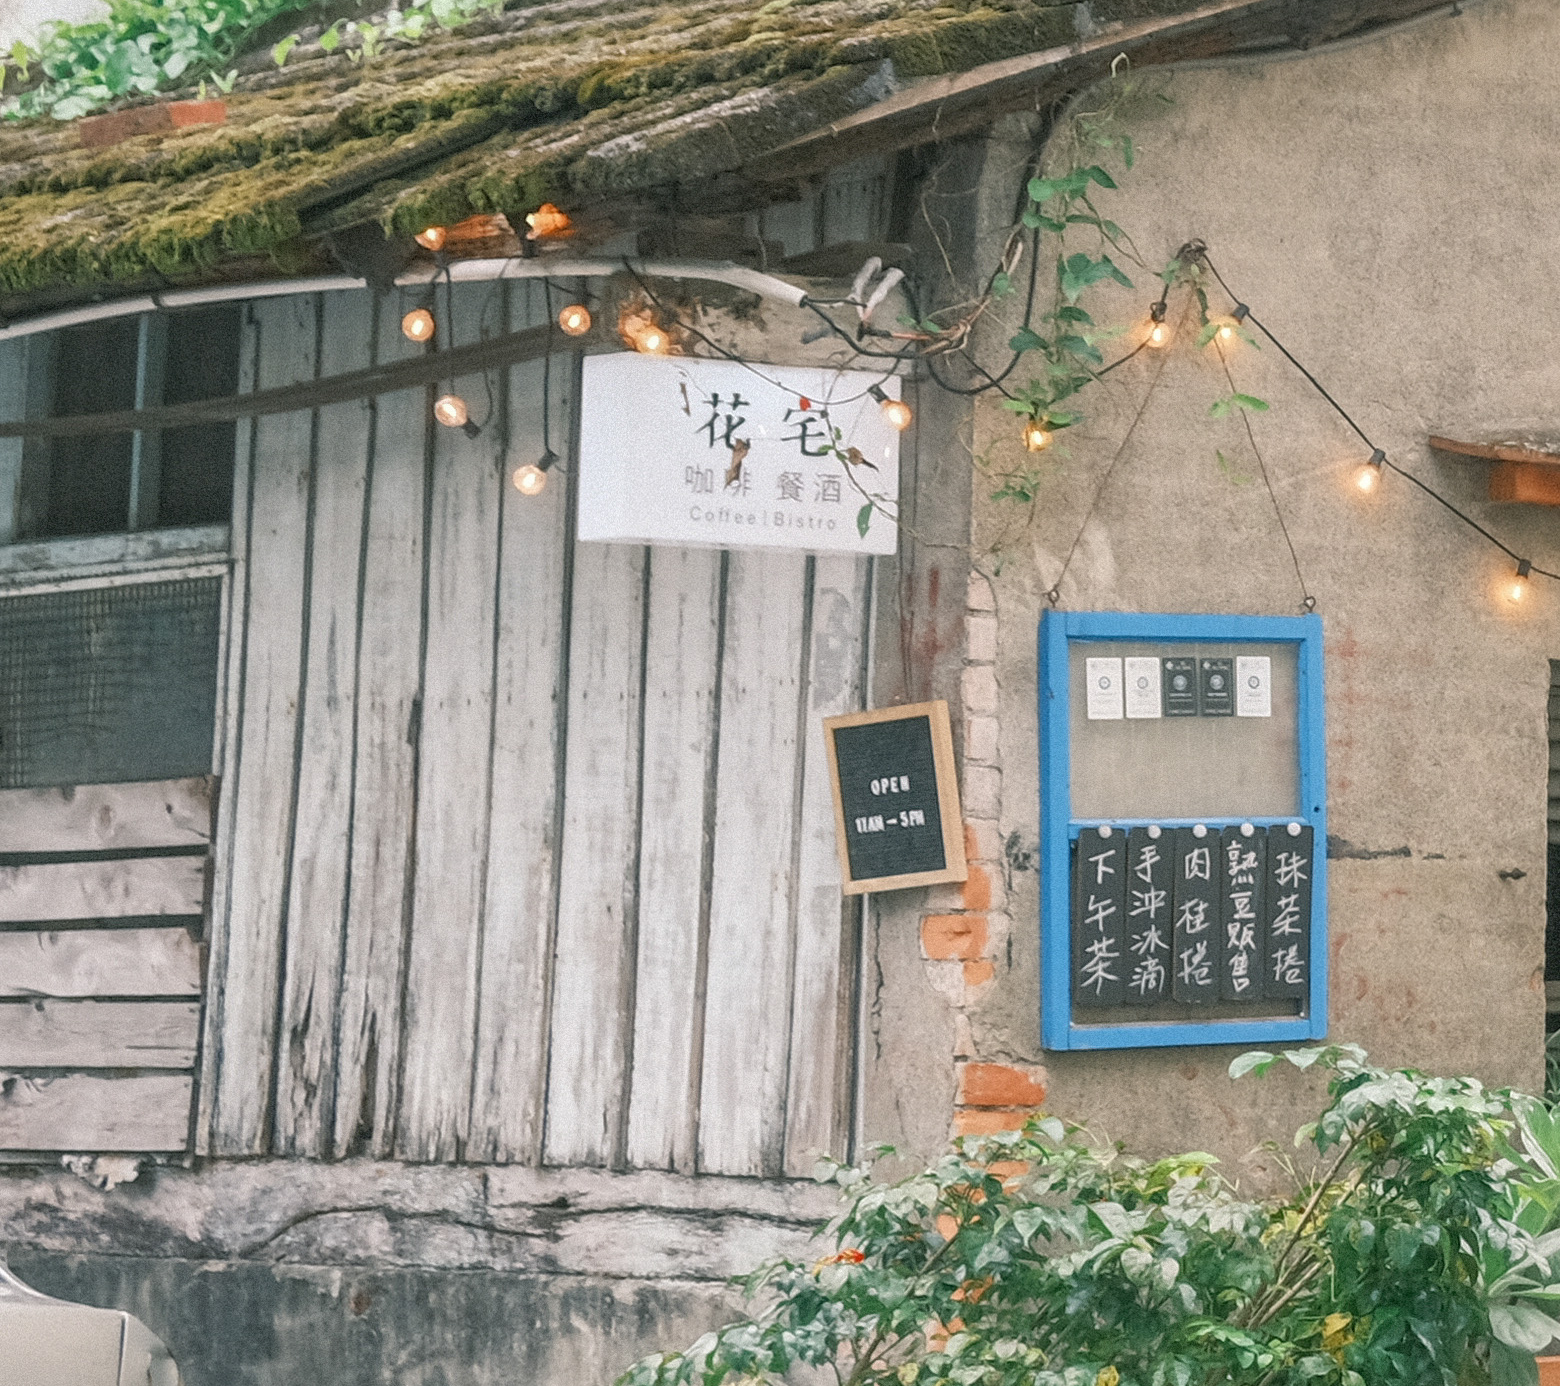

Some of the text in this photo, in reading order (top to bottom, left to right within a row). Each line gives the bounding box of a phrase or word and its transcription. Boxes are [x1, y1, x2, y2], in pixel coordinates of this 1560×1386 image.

[696, 392, 828, 457] 花宅
[777, 471, 842, 503] 餐酒
[870, 775, 910, 795] OPEN
[1081, 849, 1119, 995] 下午茶
[1176, 847, 1213, 985] 肉桂捲
[1226, 840, 1258, 992] 熟豆販售
